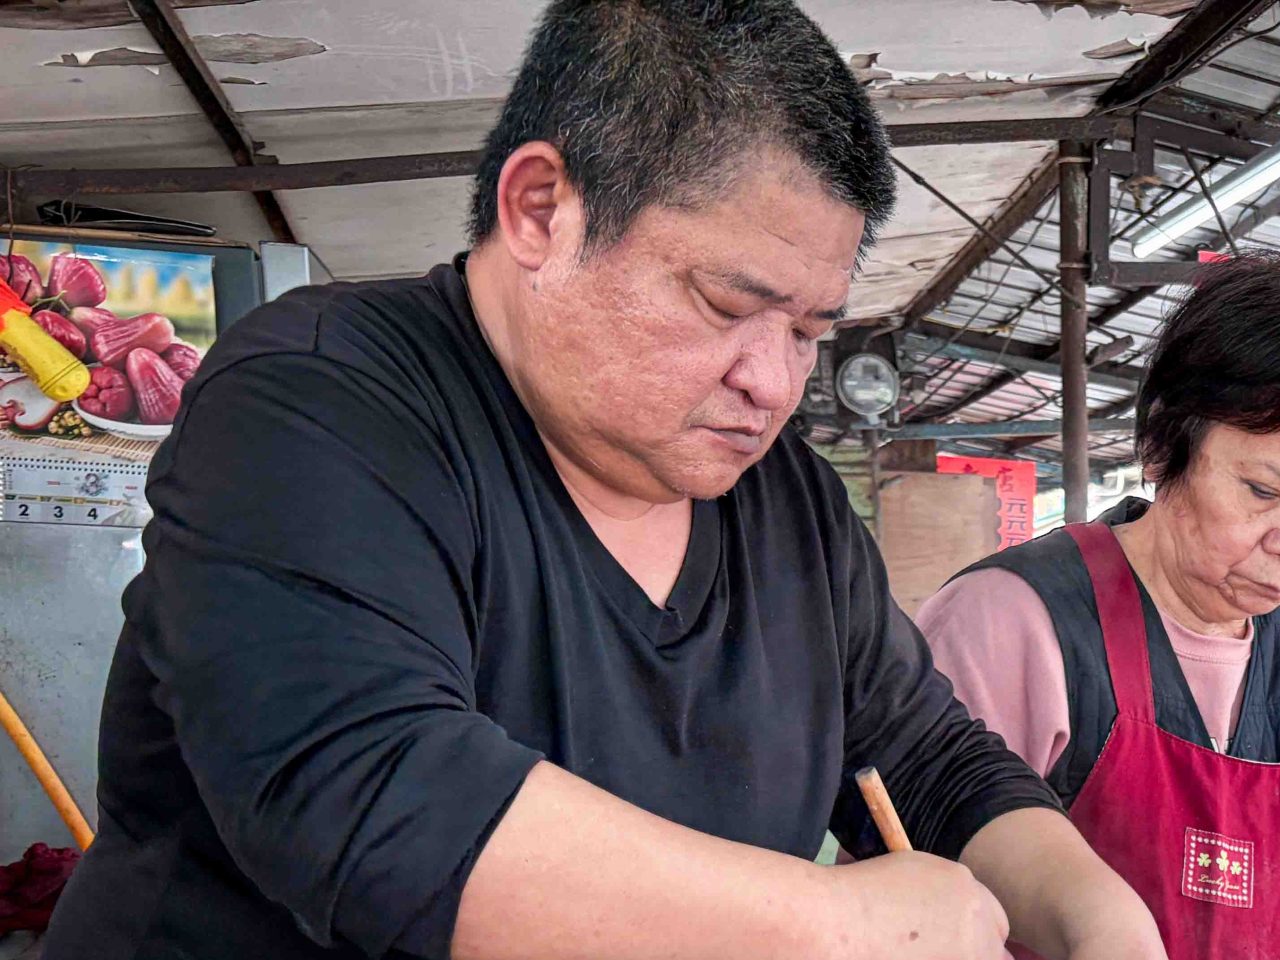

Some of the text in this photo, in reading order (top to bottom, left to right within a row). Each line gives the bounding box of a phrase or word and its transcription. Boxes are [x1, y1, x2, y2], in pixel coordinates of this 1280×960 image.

[18, 504, 98, 520] 2 3 4
